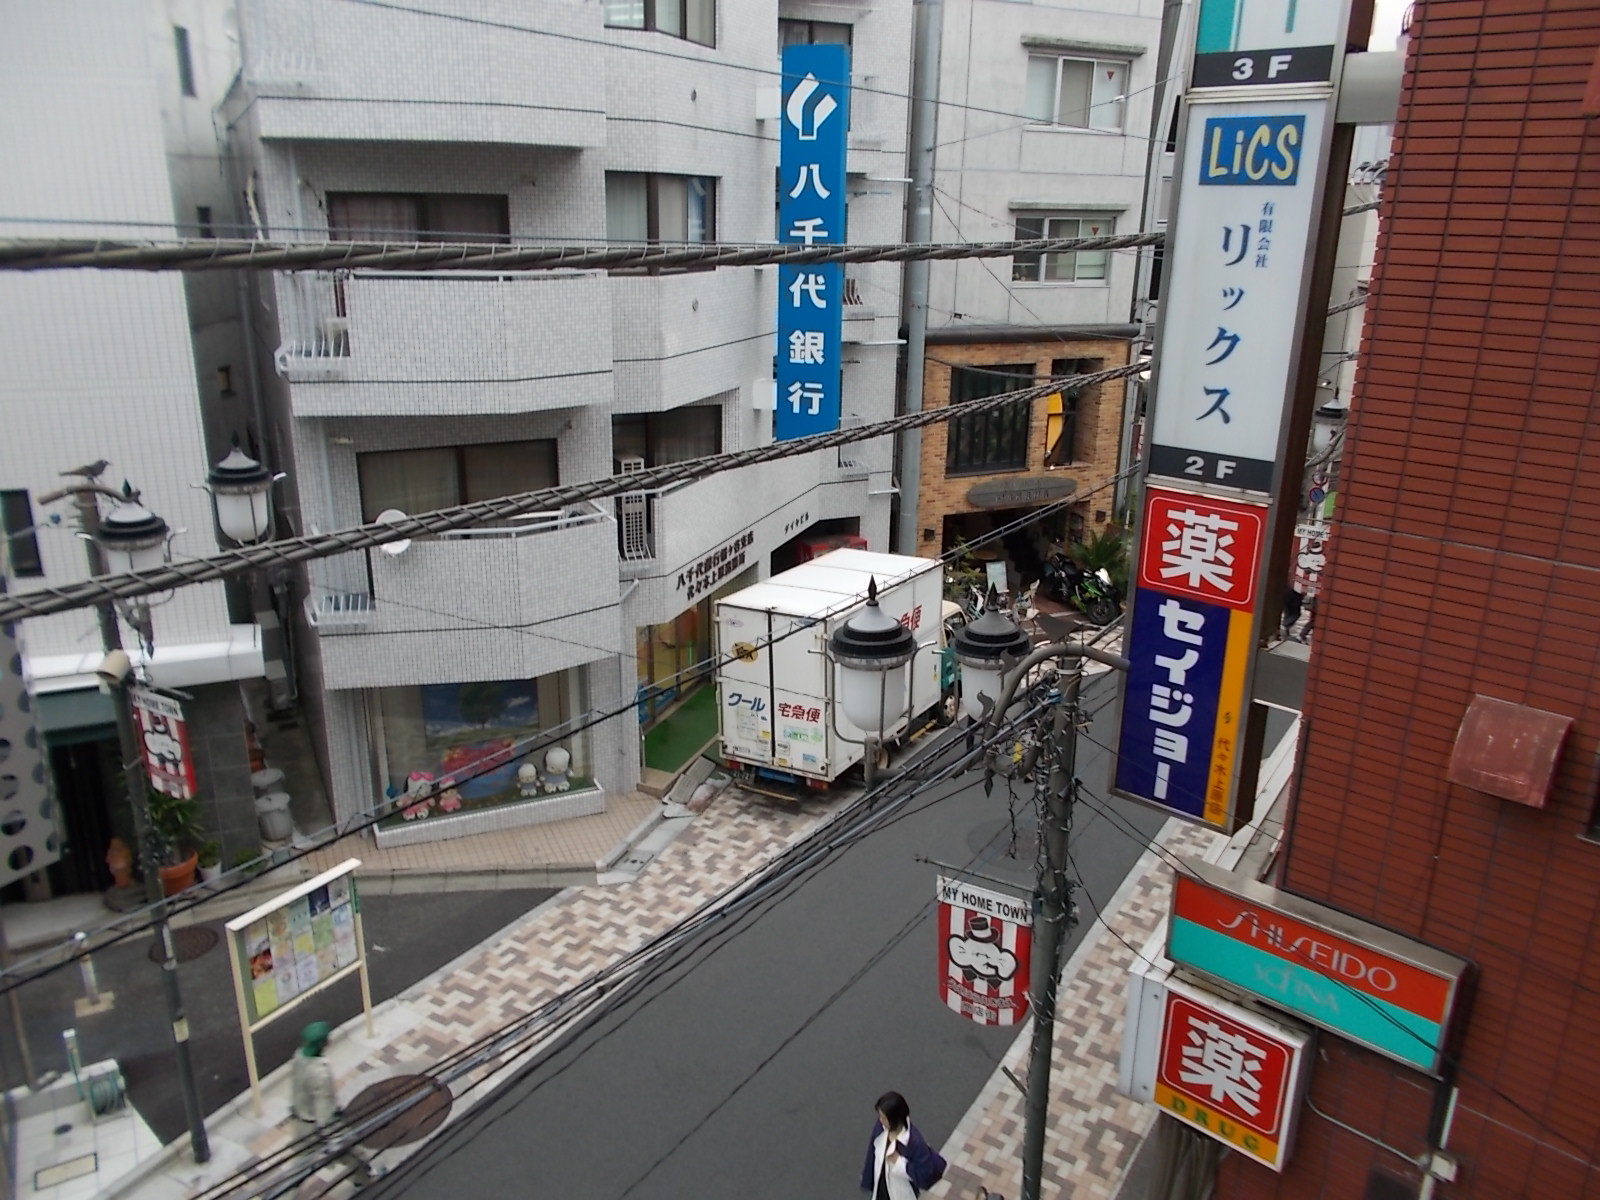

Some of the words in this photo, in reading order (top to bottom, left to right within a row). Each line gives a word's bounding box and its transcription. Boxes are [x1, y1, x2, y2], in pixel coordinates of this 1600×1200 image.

[1254, 200, 1276, 270] 有限会社
[786, 163, 831, 416] 八千代銀行
[1195, 222, 1252, 426] リックス
[1158, 508, 1240, 593] 薬
[728, 692, 766, 712] クール
[778, 702, 821, 724] 宅急便
[1147, 598, 1206, 801] セイジョー
[942, 885, 959, 901] MY
[962, 891, 993, 912] HOME
[995, 902, 1029, 923] TOWN
[1217, 910, 1397, 993] SHISEIDO
[1178, 1015, 1268, 1118] 薬
[1170, 1095, 1259, 1152] DRUG
